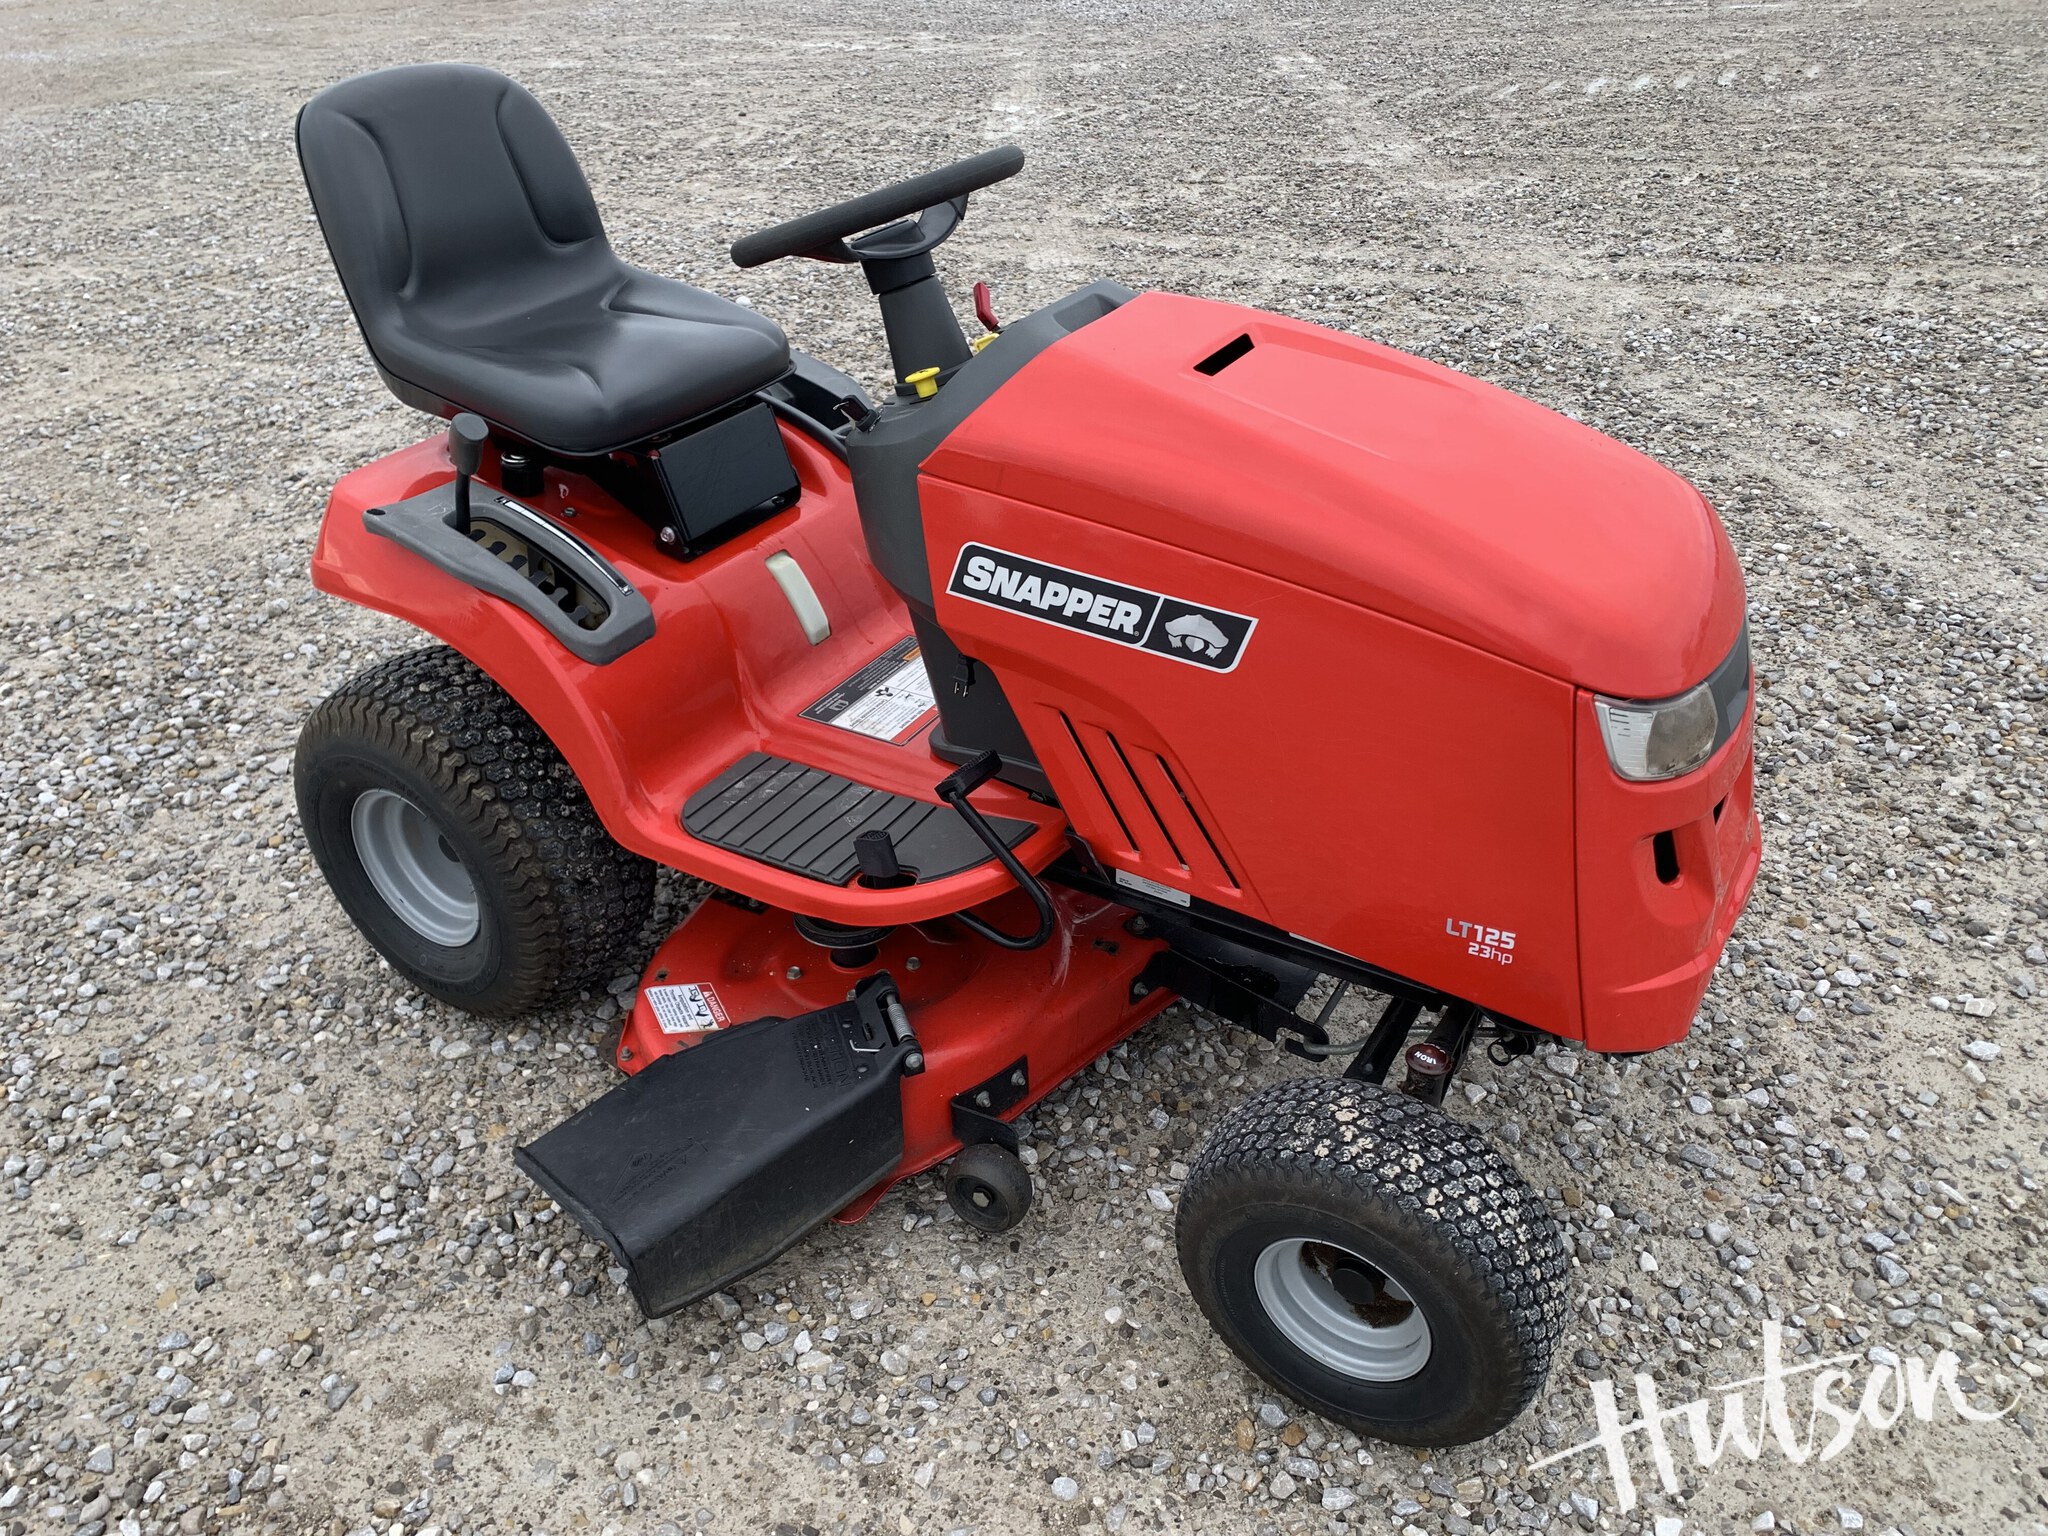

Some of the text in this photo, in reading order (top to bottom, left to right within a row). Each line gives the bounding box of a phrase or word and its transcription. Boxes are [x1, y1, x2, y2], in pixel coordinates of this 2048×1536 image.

[963, 555, 1143, 636] SNAPPER
[1446, 917, 1517, 950] LT125
[1468, 941, 1513, 965] 23hp
[707, 995, 726, 1023] DANGER
